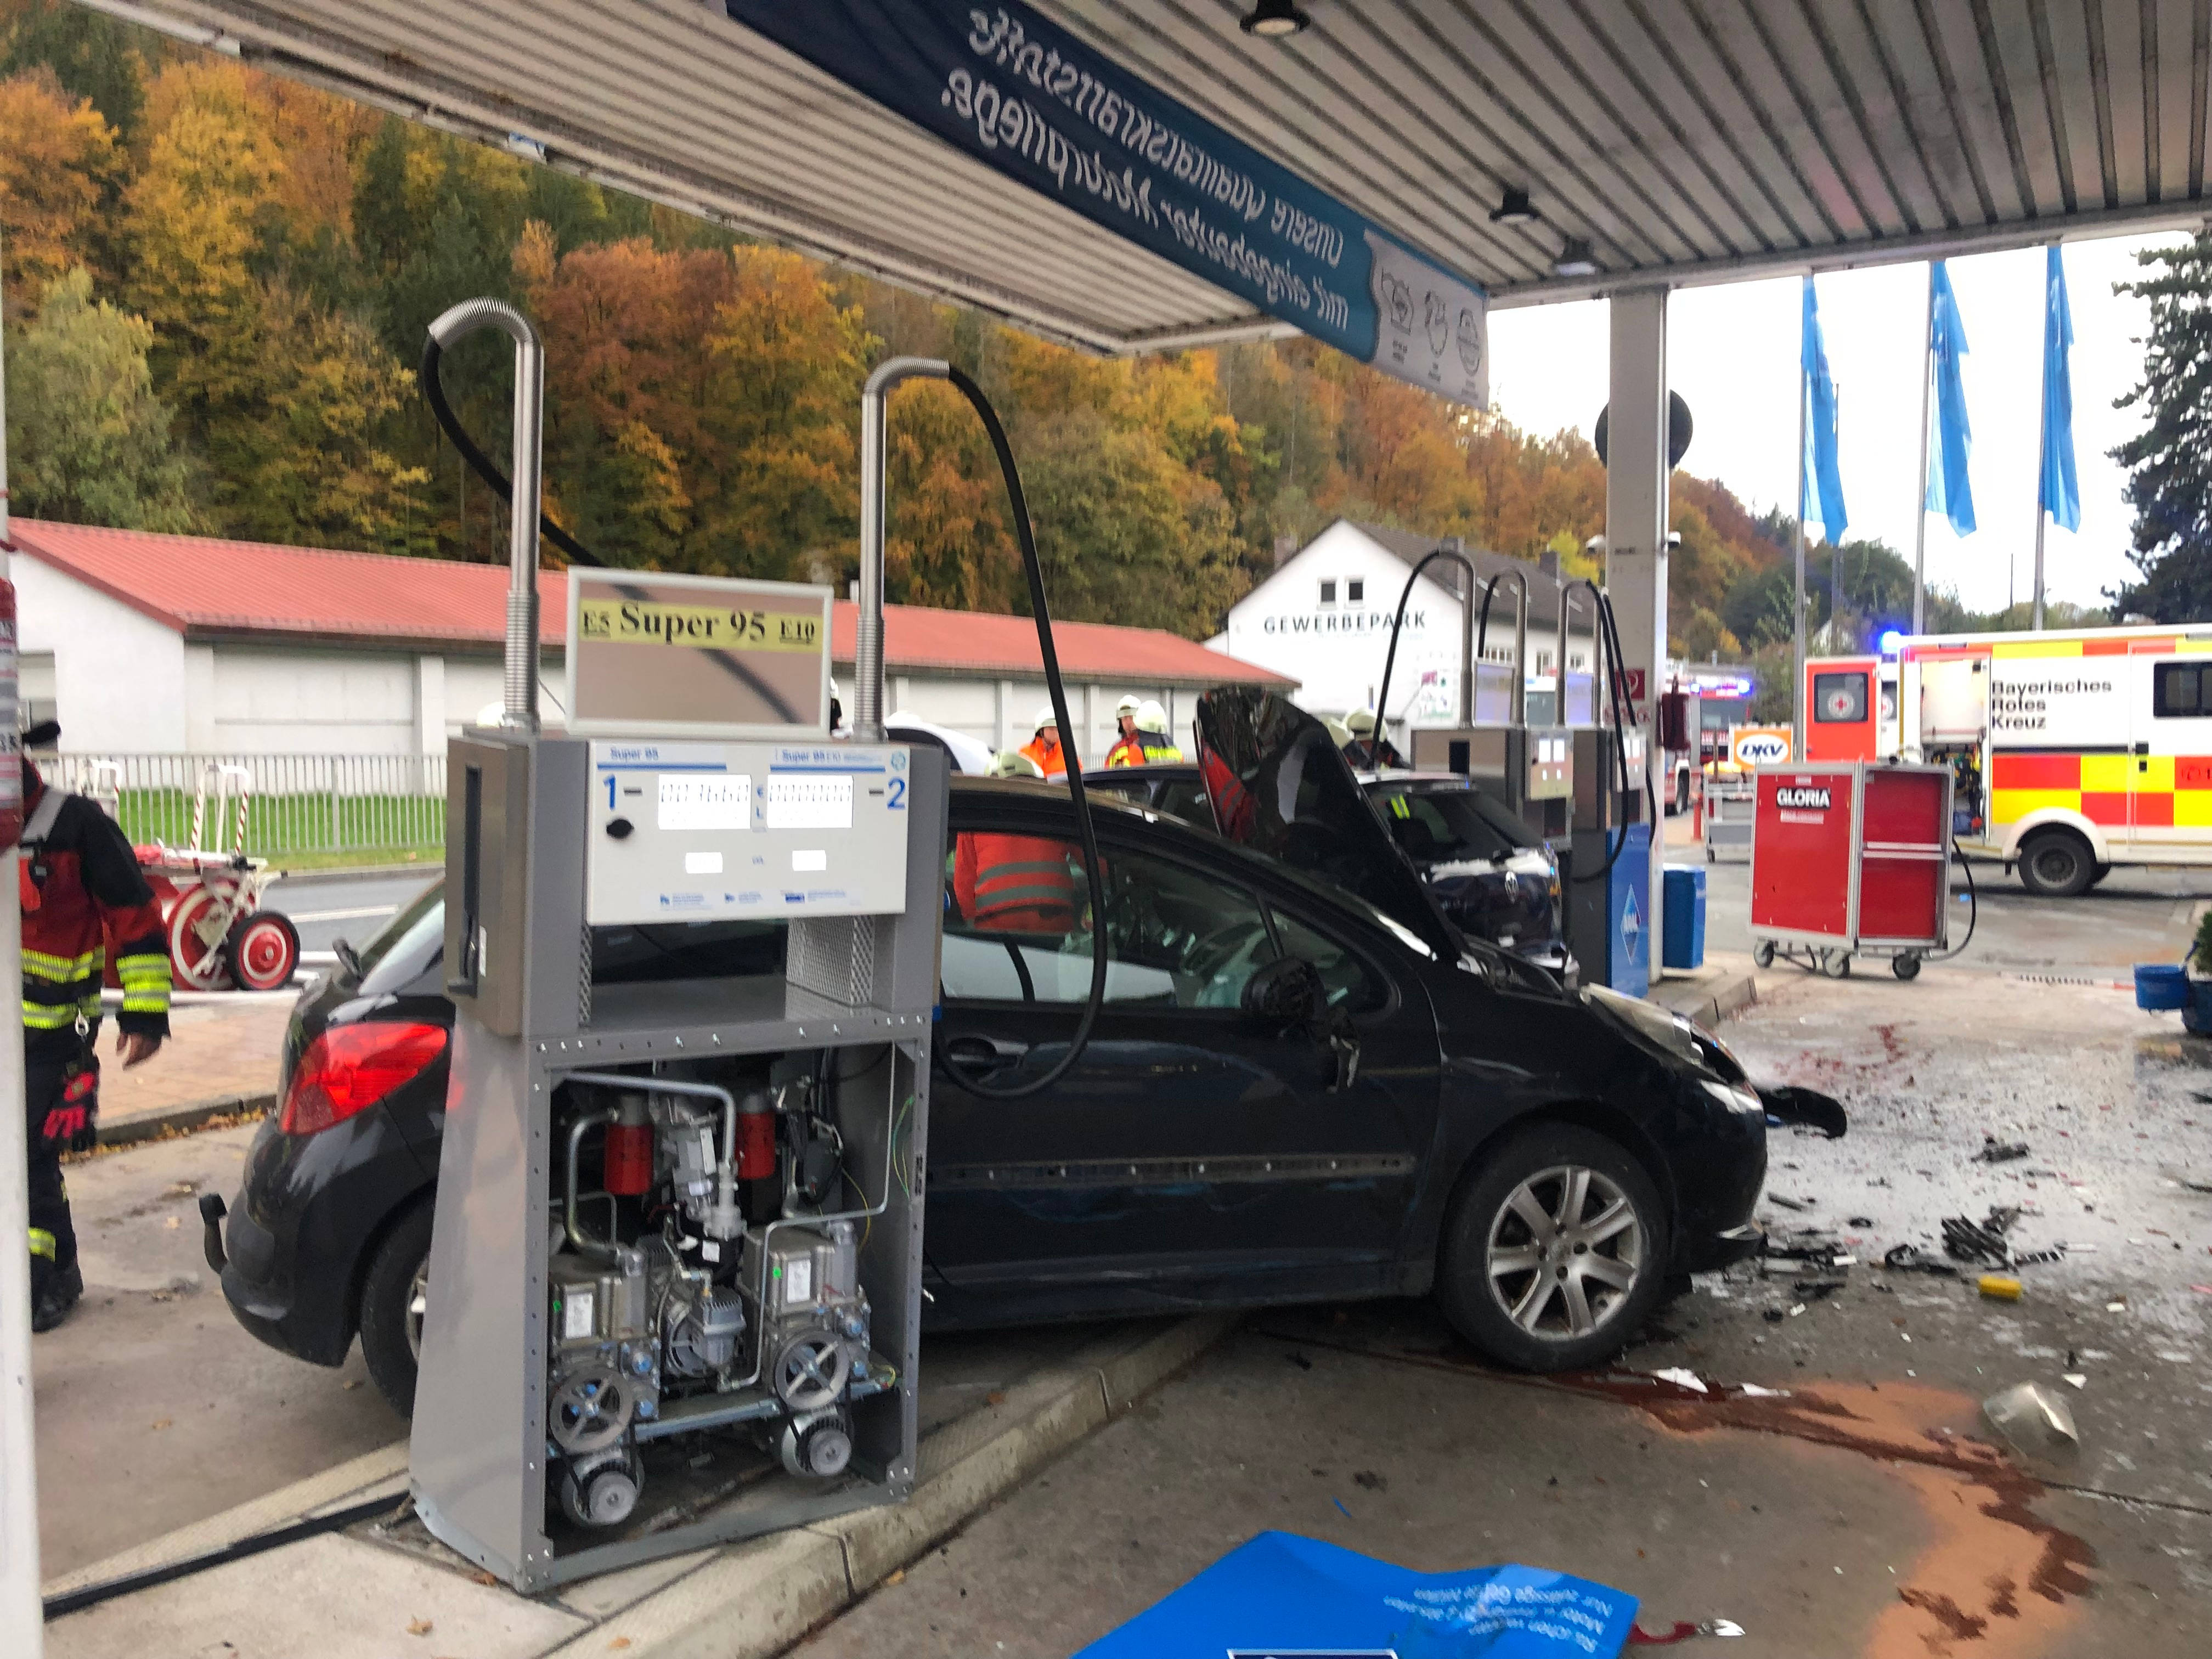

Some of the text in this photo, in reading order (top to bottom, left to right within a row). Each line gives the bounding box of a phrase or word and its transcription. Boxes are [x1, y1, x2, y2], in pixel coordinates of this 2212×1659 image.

[584, 601, 815, 645] E5 Super 95 E10
[1264, 610, 1425, 635] GEWERBEPARK
[1992, 679, 2112, 698] Bayerisches
[1992, 699, 2046, 713] Rotes
[1992, 716, 2046, 730] Kreuz
[610, 747, 641, 761] Super
[782, 749, 809, 763] Super
[1741, 743, 1784, 757] DKV
[602, 774, 616, 811] 1
[887, 776, 906, 810] 2
[1776, 787, 1830, 807] GLORIA
